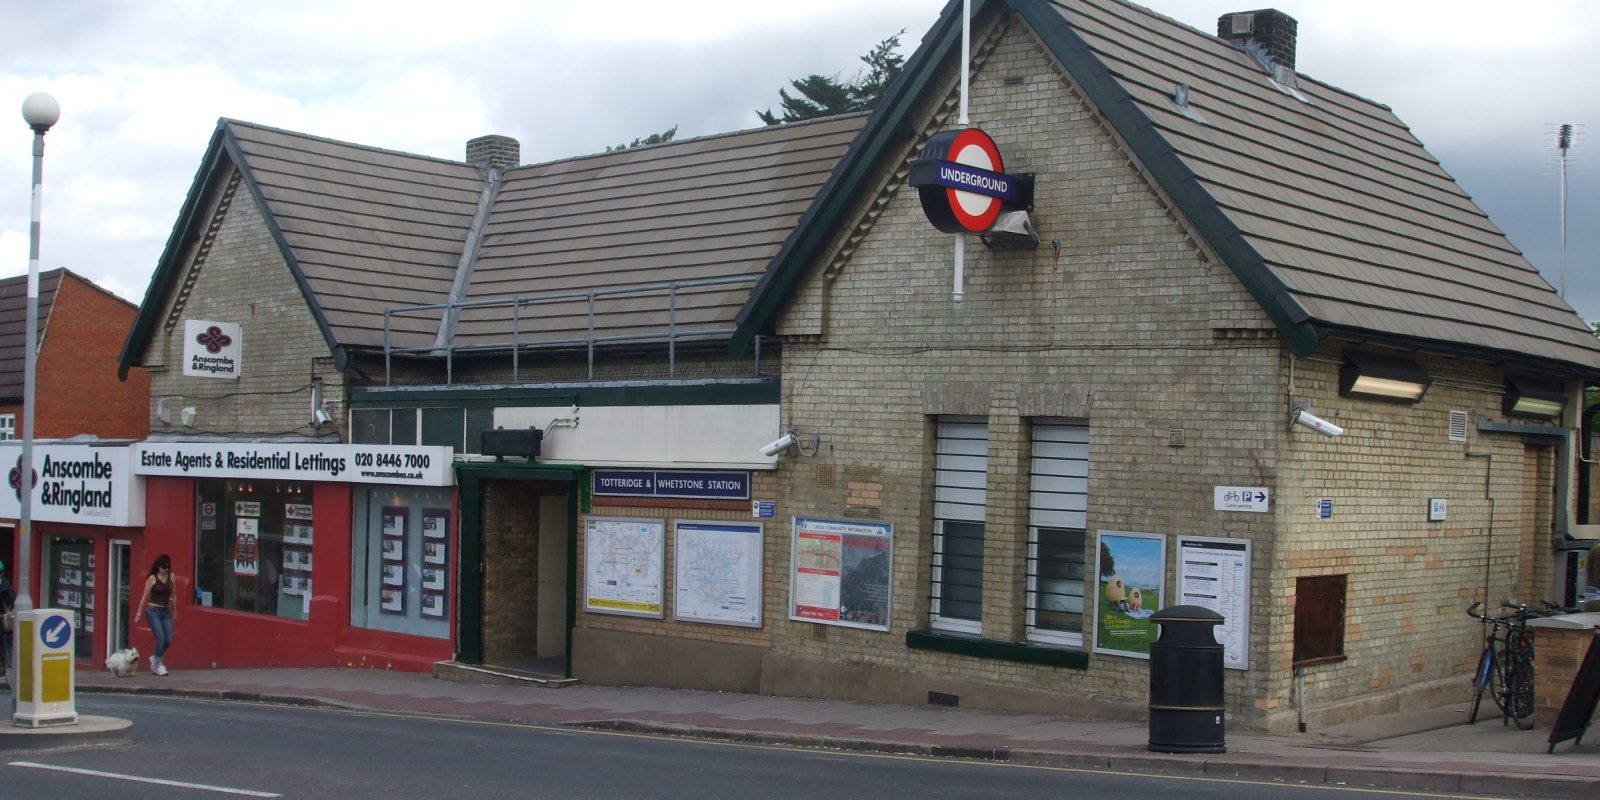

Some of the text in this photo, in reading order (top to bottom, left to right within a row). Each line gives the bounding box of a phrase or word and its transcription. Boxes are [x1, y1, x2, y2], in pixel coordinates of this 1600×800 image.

[941, 167, 1008, 192] UNDERGROUND
[192, 354, 234, 365] Anscombe
[42, 452, 112, 479] Anscombe
[141, 450, 430, 476] Estate Agents & Residential Lettings 020 8446 7000
[601, 478, 741, 490] TOTTERIDGE & WHETSTONE STATION
[41, 480, 112, 514] &Ringland
